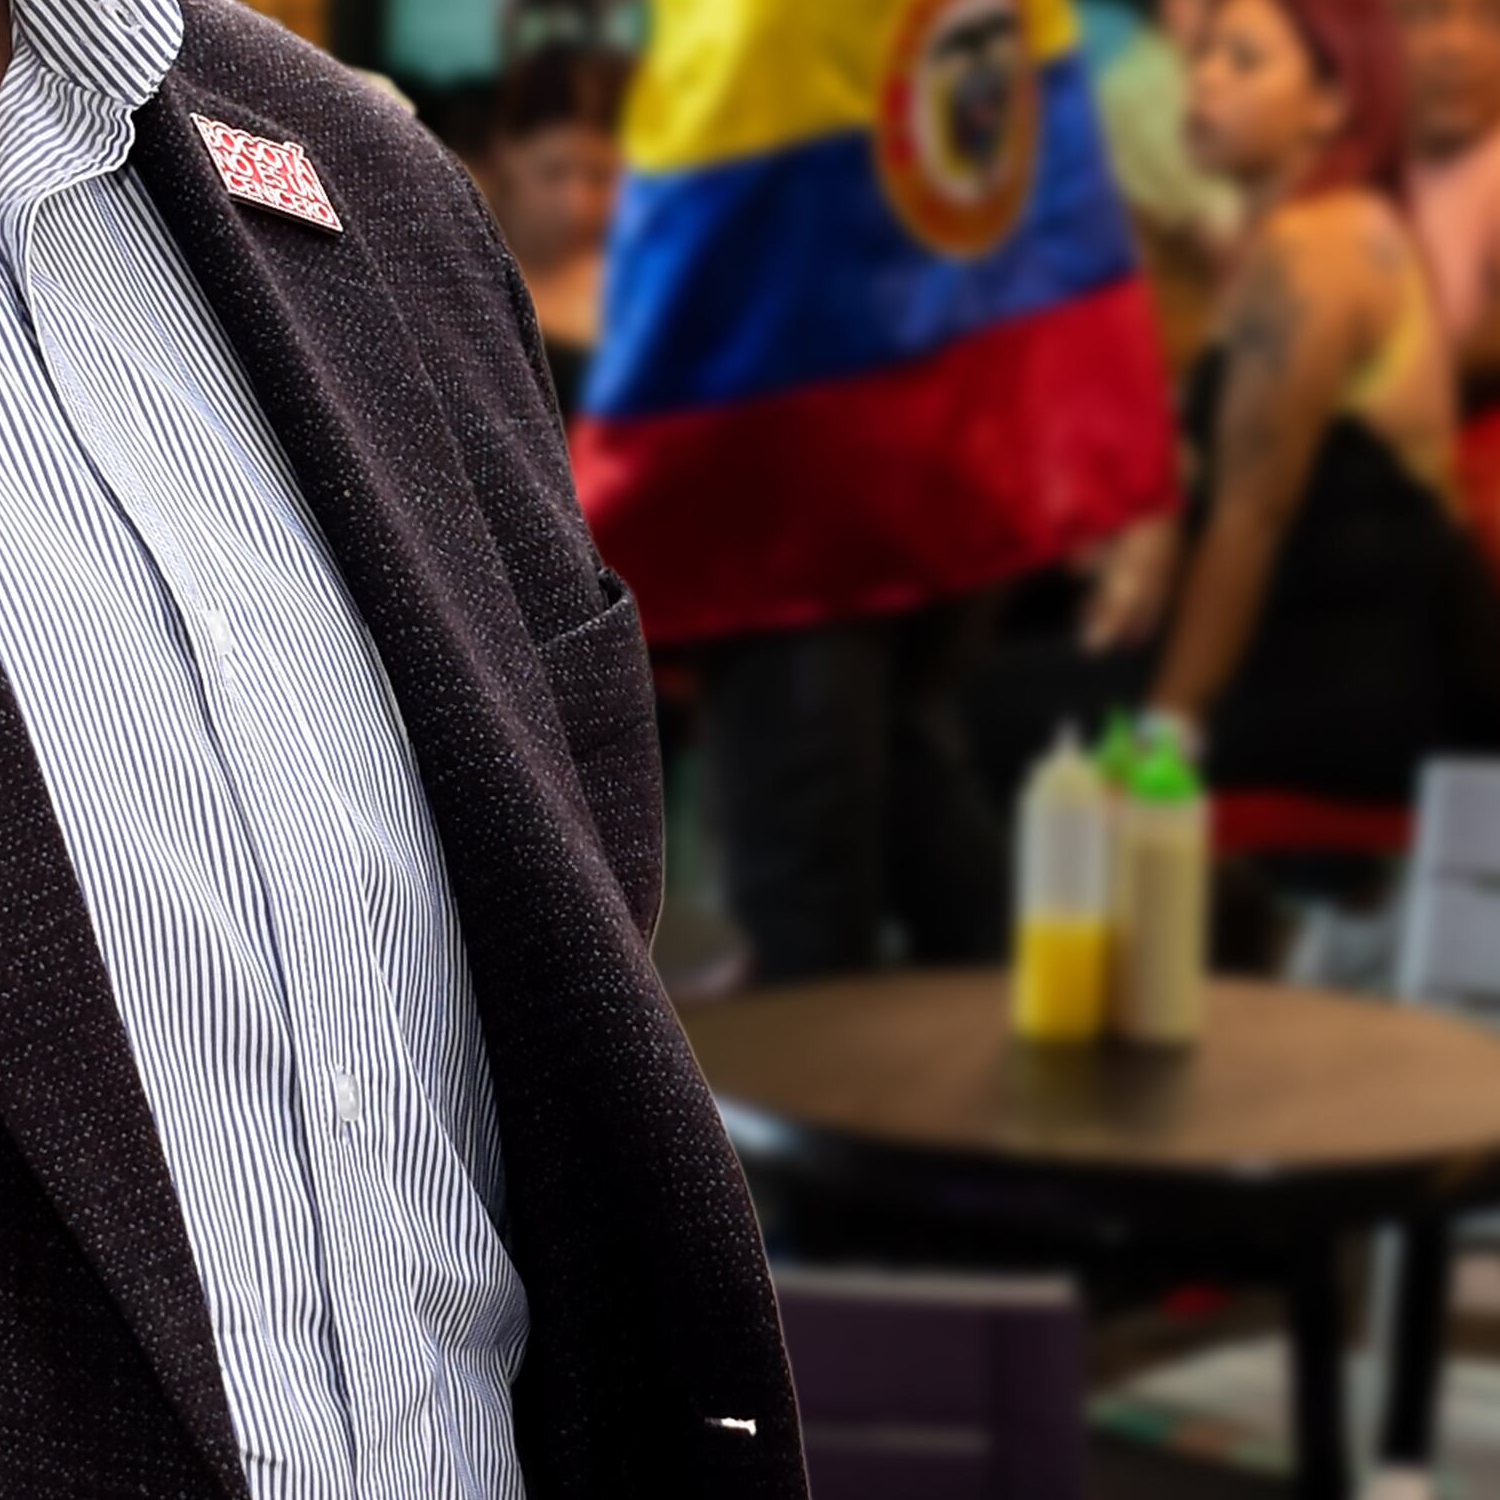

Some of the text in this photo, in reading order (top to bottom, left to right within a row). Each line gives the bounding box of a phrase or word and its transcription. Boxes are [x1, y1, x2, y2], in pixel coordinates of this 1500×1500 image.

[199, 121, 316, 181] BOGOTÁ
[211, 146, 326, 204] NO ES UN
[228, 173, 331, 223] CENICERO
